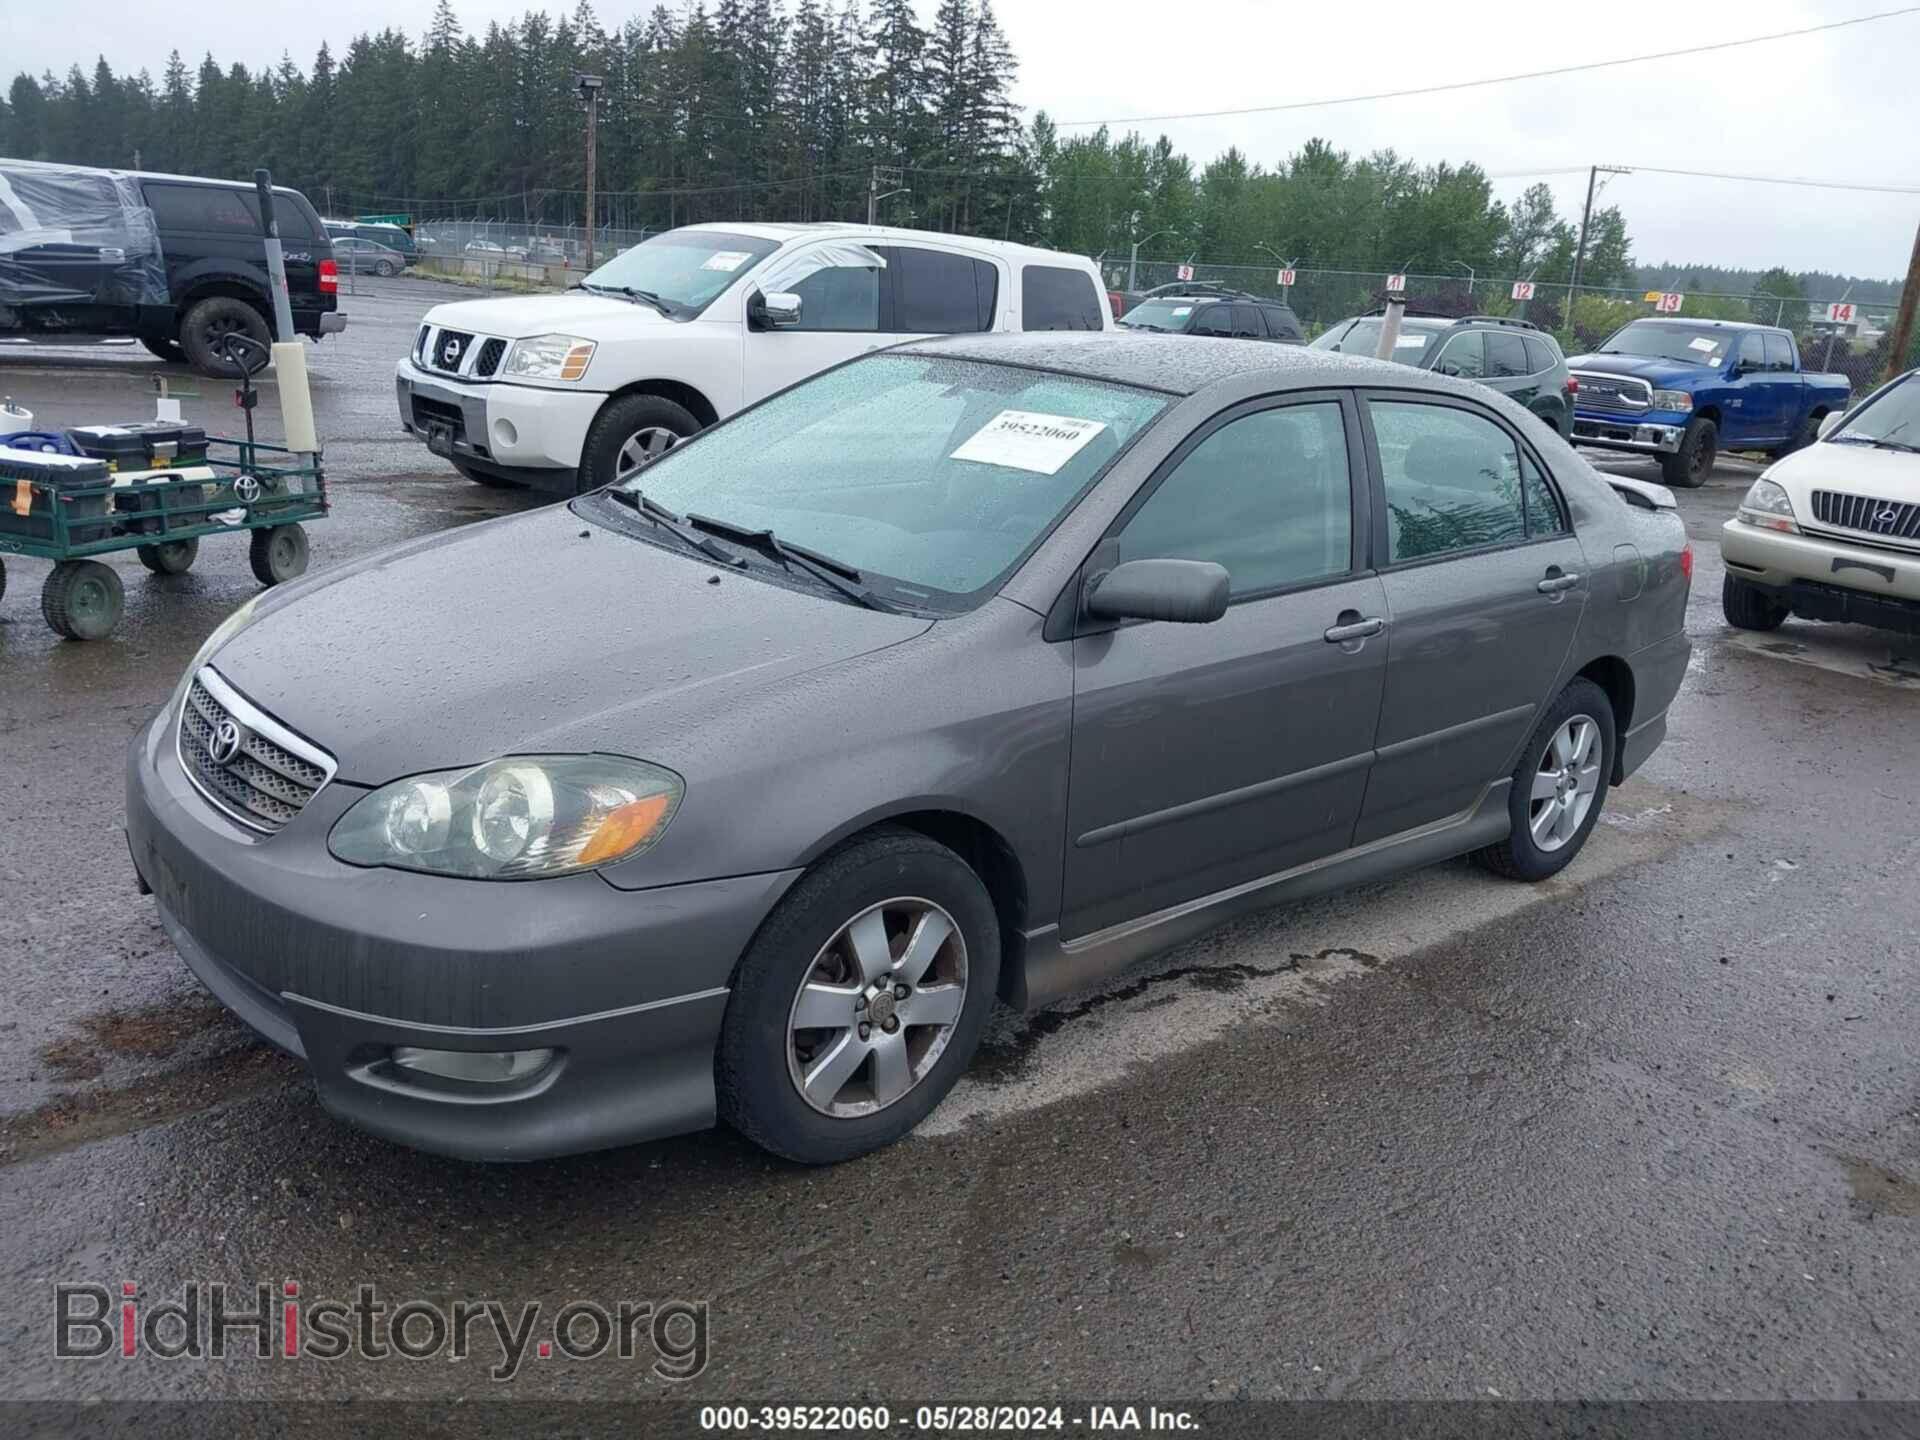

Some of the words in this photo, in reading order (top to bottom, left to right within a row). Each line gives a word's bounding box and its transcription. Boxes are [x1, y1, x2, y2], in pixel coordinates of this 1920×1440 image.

[1182, 267, 1190, 280] 9
[1282, 270, 1293, 284] 10
[1515, 283, 1531, 298] 12
[1662, 293, 1679, 310] 13
[1831, 303, 1851, 321] 14
[993, 421, 1080, 440] 39522060
